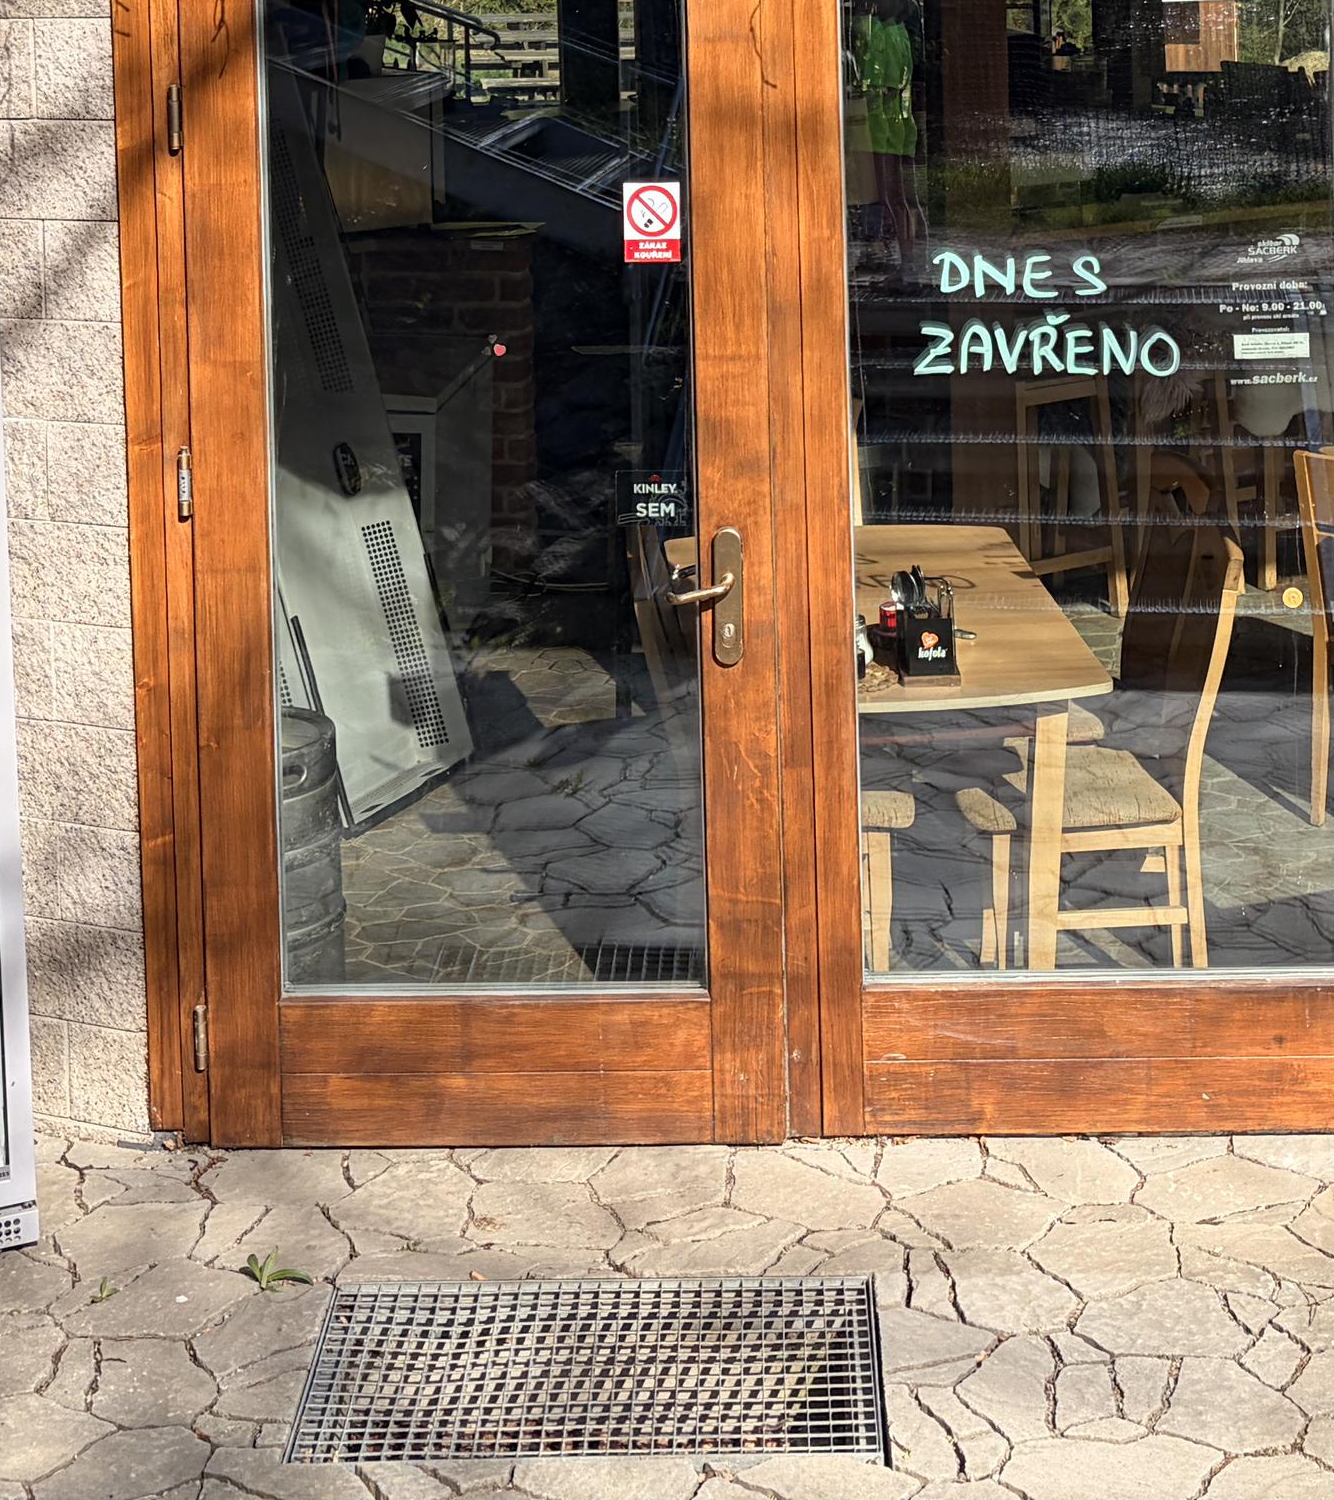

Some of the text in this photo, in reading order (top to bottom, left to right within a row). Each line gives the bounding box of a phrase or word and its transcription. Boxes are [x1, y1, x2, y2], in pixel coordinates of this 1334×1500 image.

[1247, 245, 1298, 256] ŠACBERK
[932, 251, 1108, 298] DNES
[1219, 304, 1234, 313] Po
[1241, 303, 1260, 312] Ne:
[1261, 302, 1285, 312] 9.00
[1293, 300, 1323, 311] 21.00
[913, 312, 1182, 377] ZAVŘENO
[633, 483, 677, 494] KINLEY
[635, 502, 676, 518] SEM
[918, 646, 947, 661] kofola
